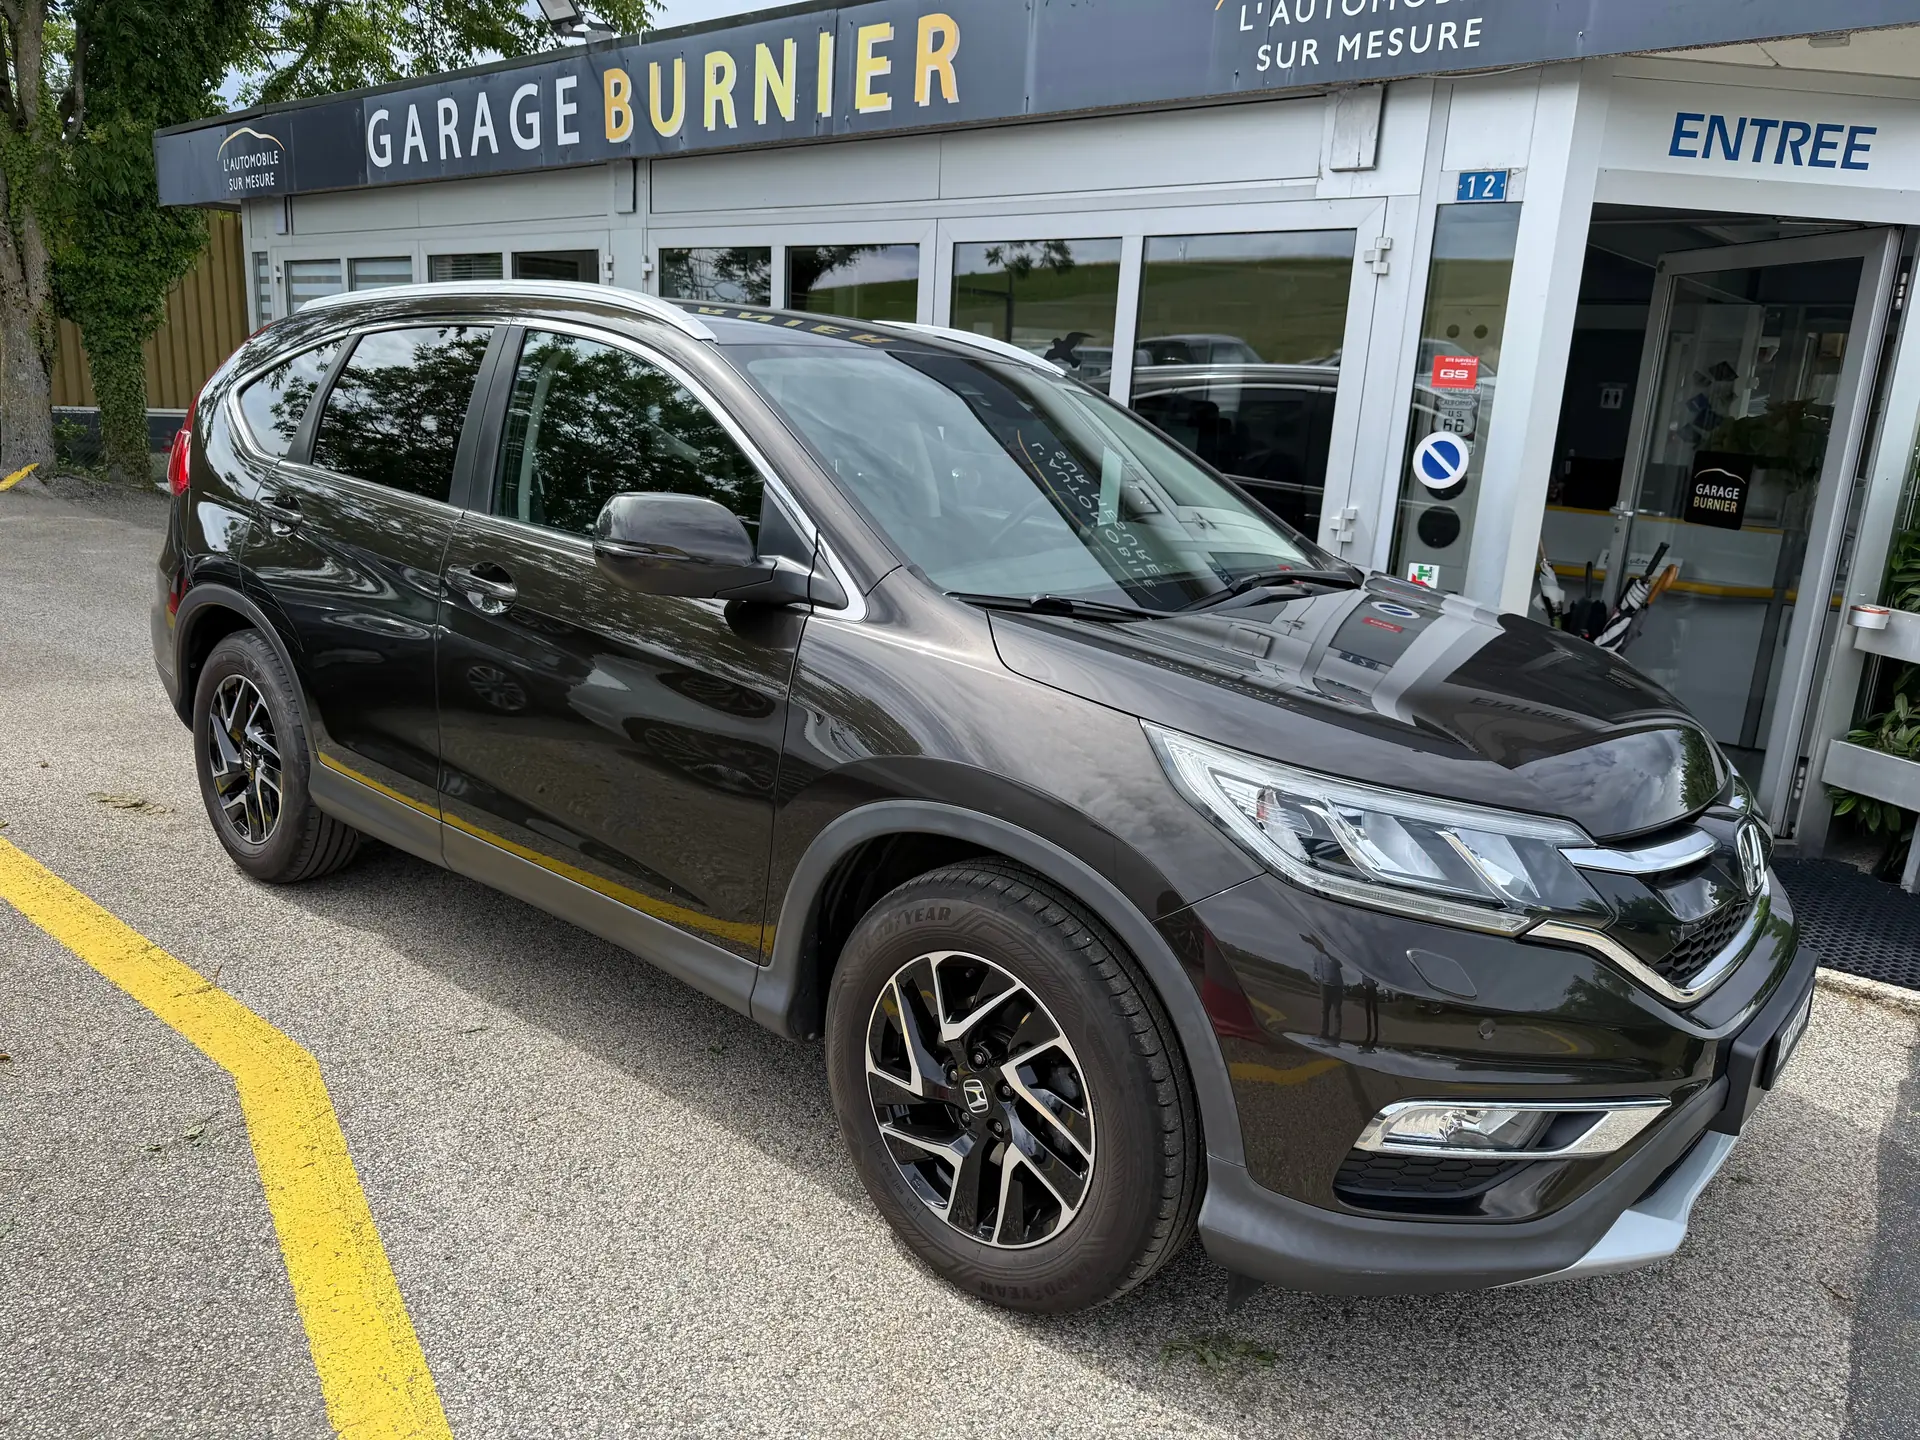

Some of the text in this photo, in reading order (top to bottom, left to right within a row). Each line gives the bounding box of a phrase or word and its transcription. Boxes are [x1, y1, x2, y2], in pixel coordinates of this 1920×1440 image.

[1256, 18, 1483, 72] SUR MESURE
[367, 13, 960, 168] GARAGE BURNIER
[1668, 112, 1878, 171] ENTREE
[223, 150, 279, 172] L'AUTOMOBILE
[228, 172, 275, 191] SUR MESURE
[1467, 174, 1495, 198] 12
[1440, 369, 1468, 379] GS
[1443, 418, 1464, 433] 66
[1696, 483, 1740, 500] GARAGE
[1693, 496, 1737, 513] BURNIER
